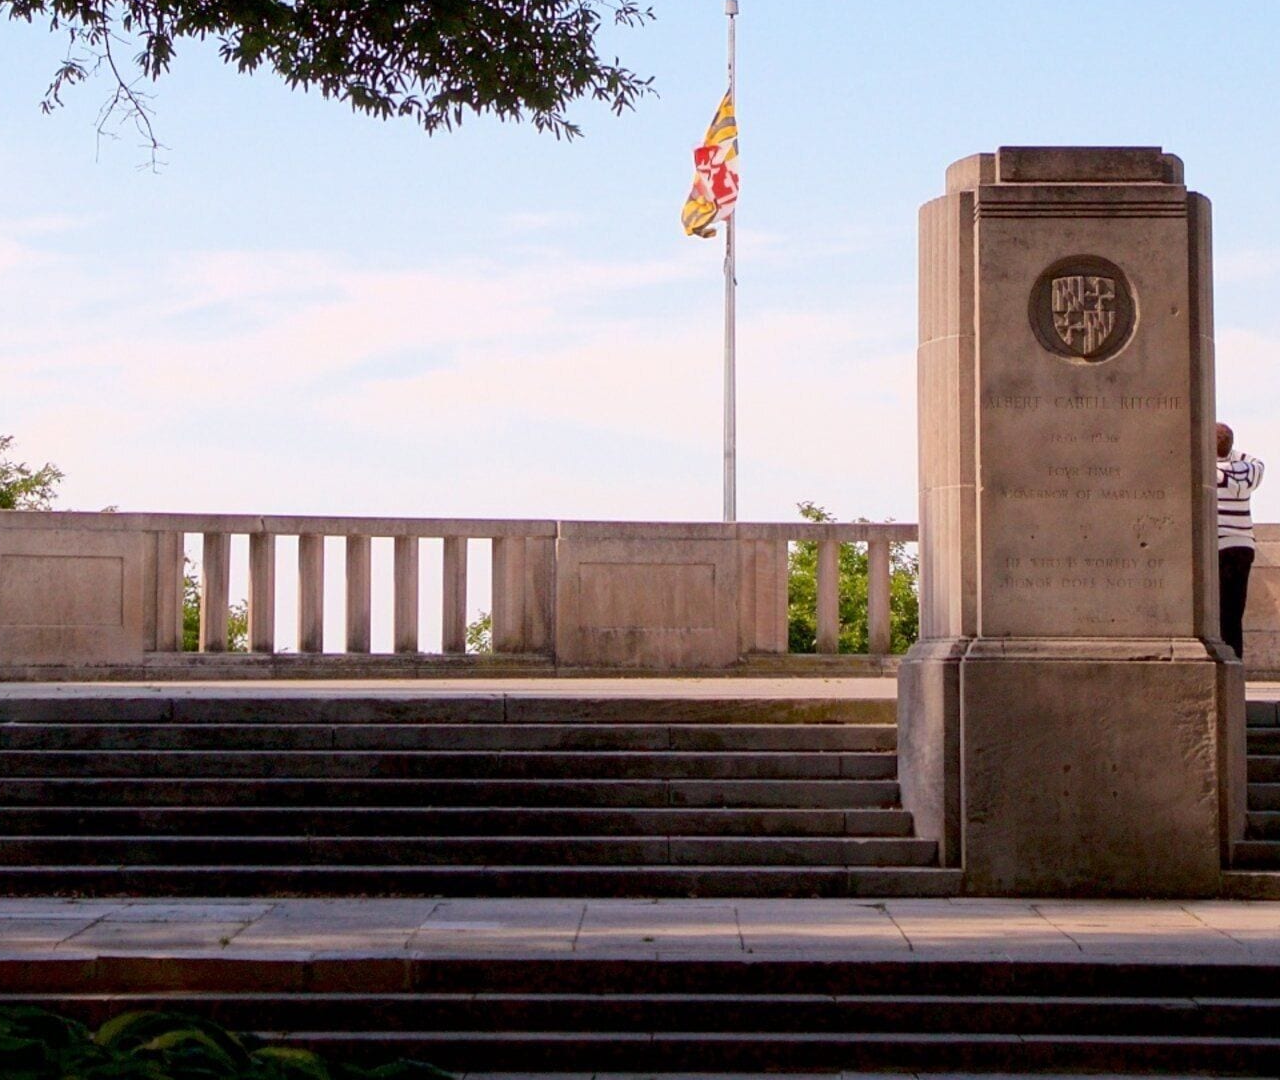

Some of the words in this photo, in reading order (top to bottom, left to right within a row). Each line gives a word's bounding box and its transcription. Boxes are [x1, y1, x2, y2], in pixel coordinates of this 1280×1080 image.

[986, 395, 1041, 409] ALBERT
[1055, 395, 1112, 409] CABELL
[1120, 395, 1183, 409] RITCHIE
[1076, 489, 1092, 500] OF
[1102, 489, 1165, 500] MARYLAND
[1147, 558, 1165, 568] OF
[1106, 578, 1134, 588] NOT
[1144, 578, 1165, 588] DIE
